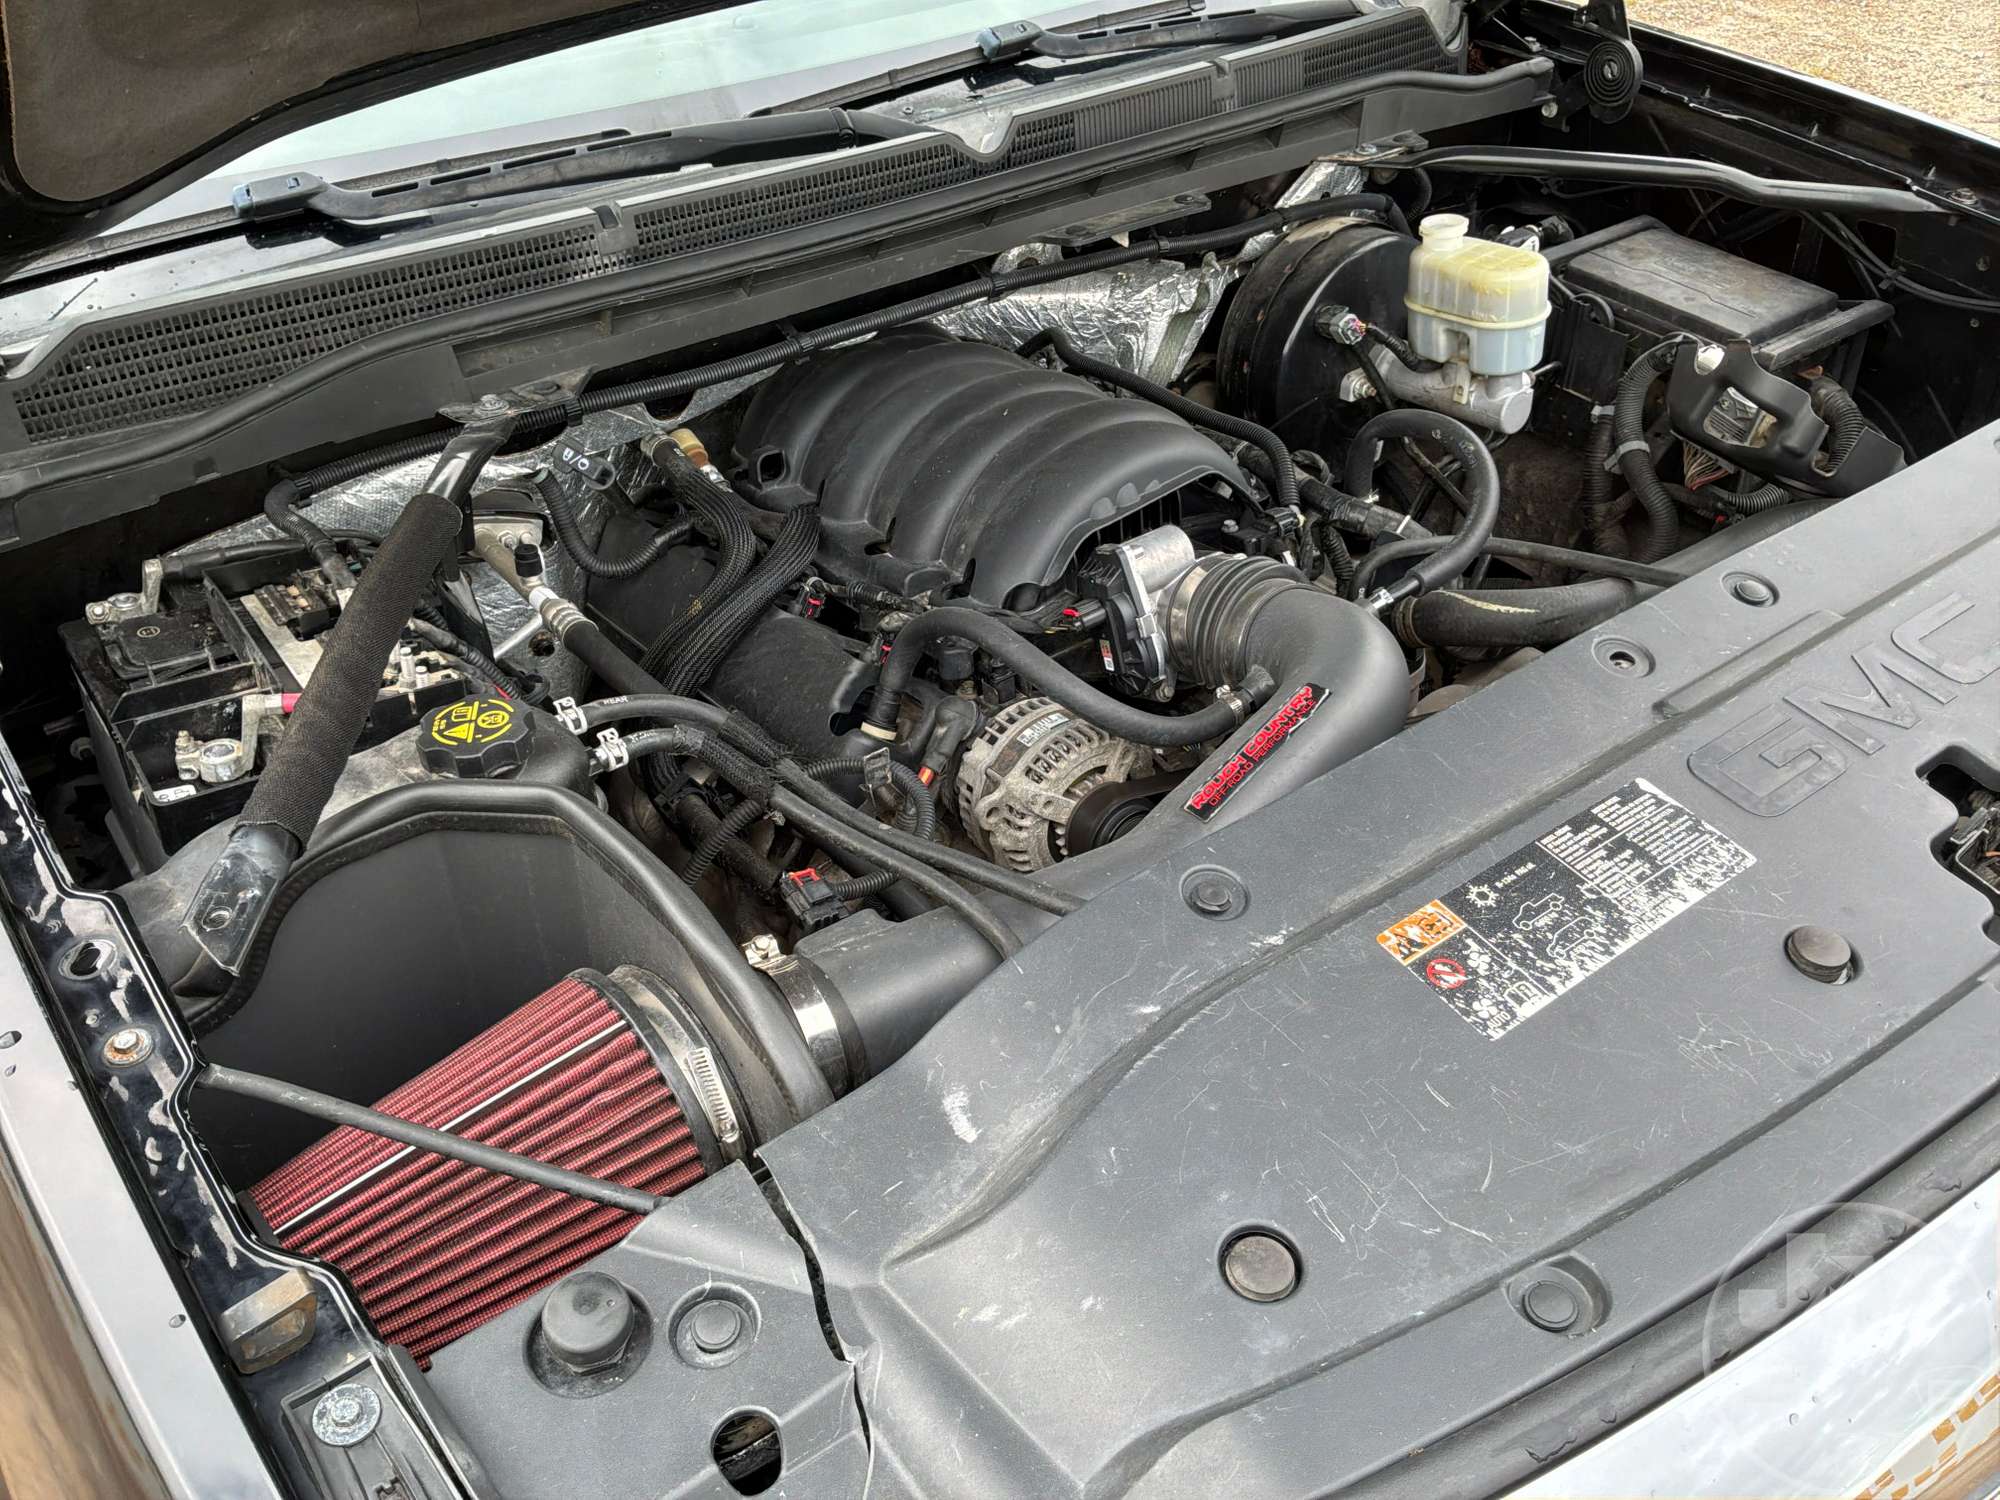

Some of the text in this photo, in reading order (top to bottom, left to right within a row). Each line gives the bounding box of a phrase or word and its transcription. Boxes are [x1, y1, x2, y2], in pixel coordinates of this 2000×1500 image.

[1192, 686, 1314, 810] ROUGH COUNTRY
[1208, 699, 1316, 807] OFF-ROAD PERFORMANCE
[1687, 590, 2000, 818] GMC
